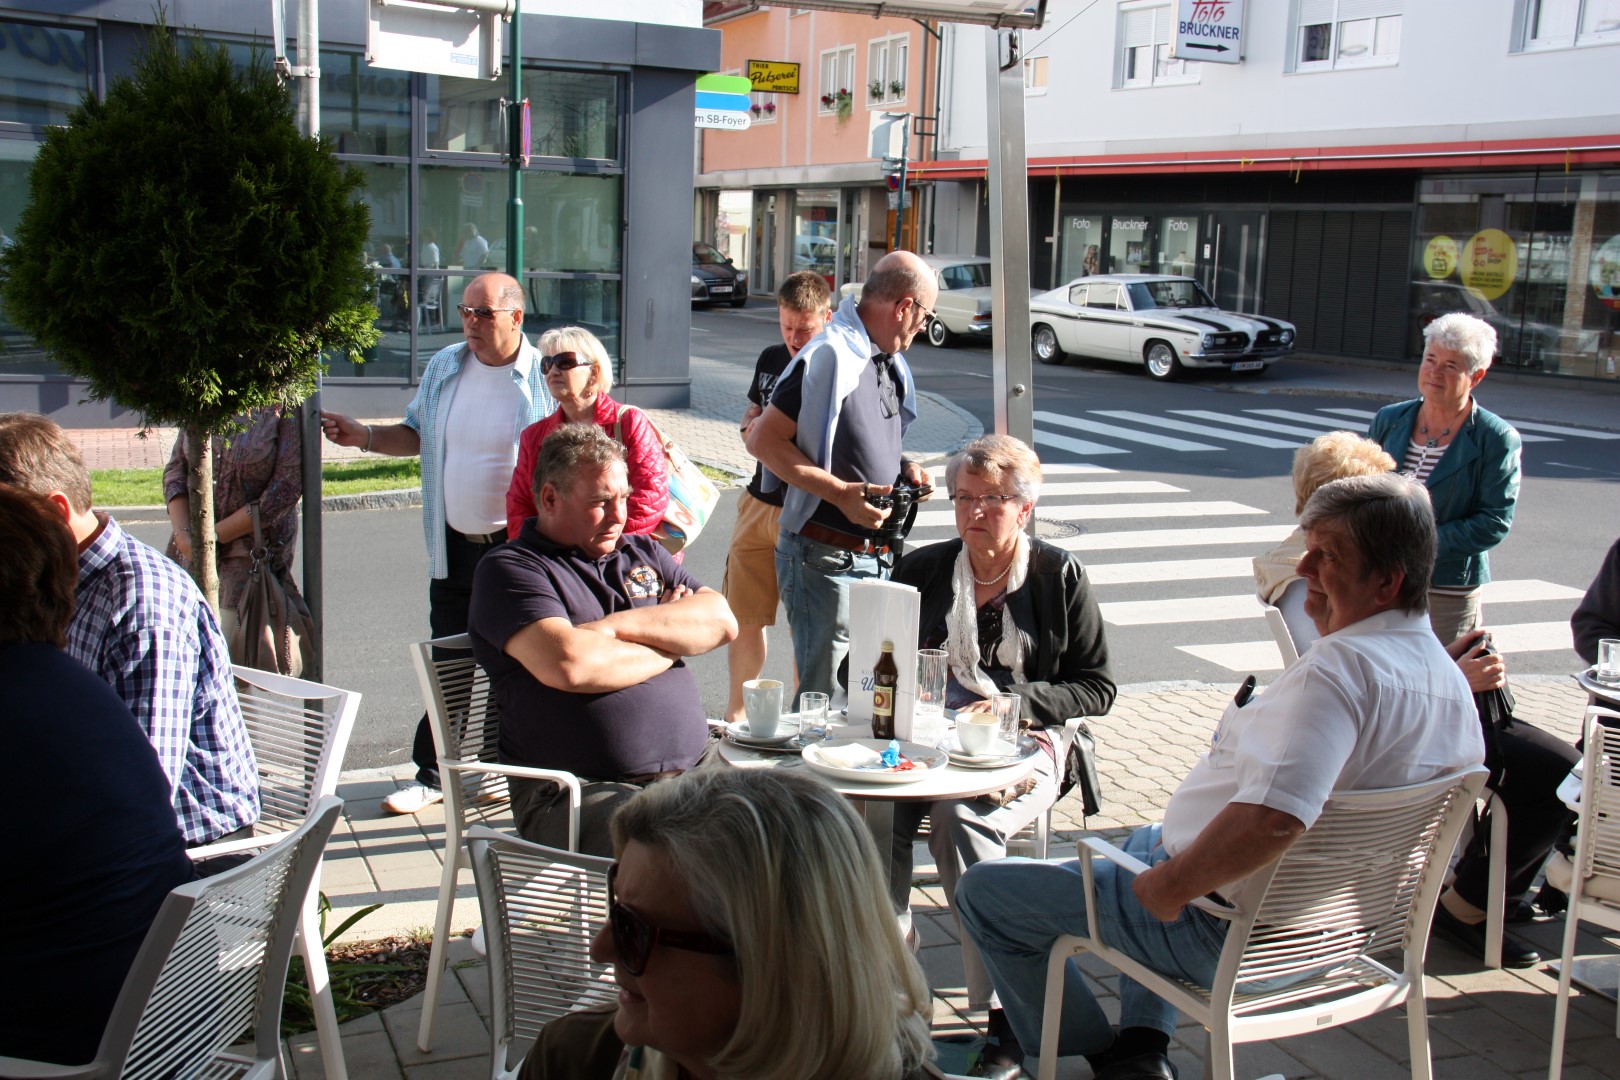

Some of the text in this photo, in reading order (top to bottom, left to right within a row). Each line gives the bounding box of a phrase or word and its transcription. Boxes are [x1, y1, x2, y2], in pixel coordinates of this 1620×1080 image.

[1179, 21, 1240, 40] BRUCKNER
[706, 114, 747, 126] SB-Foyer
[1072, 218, 1189, 231] Foto Bruckner Foto
